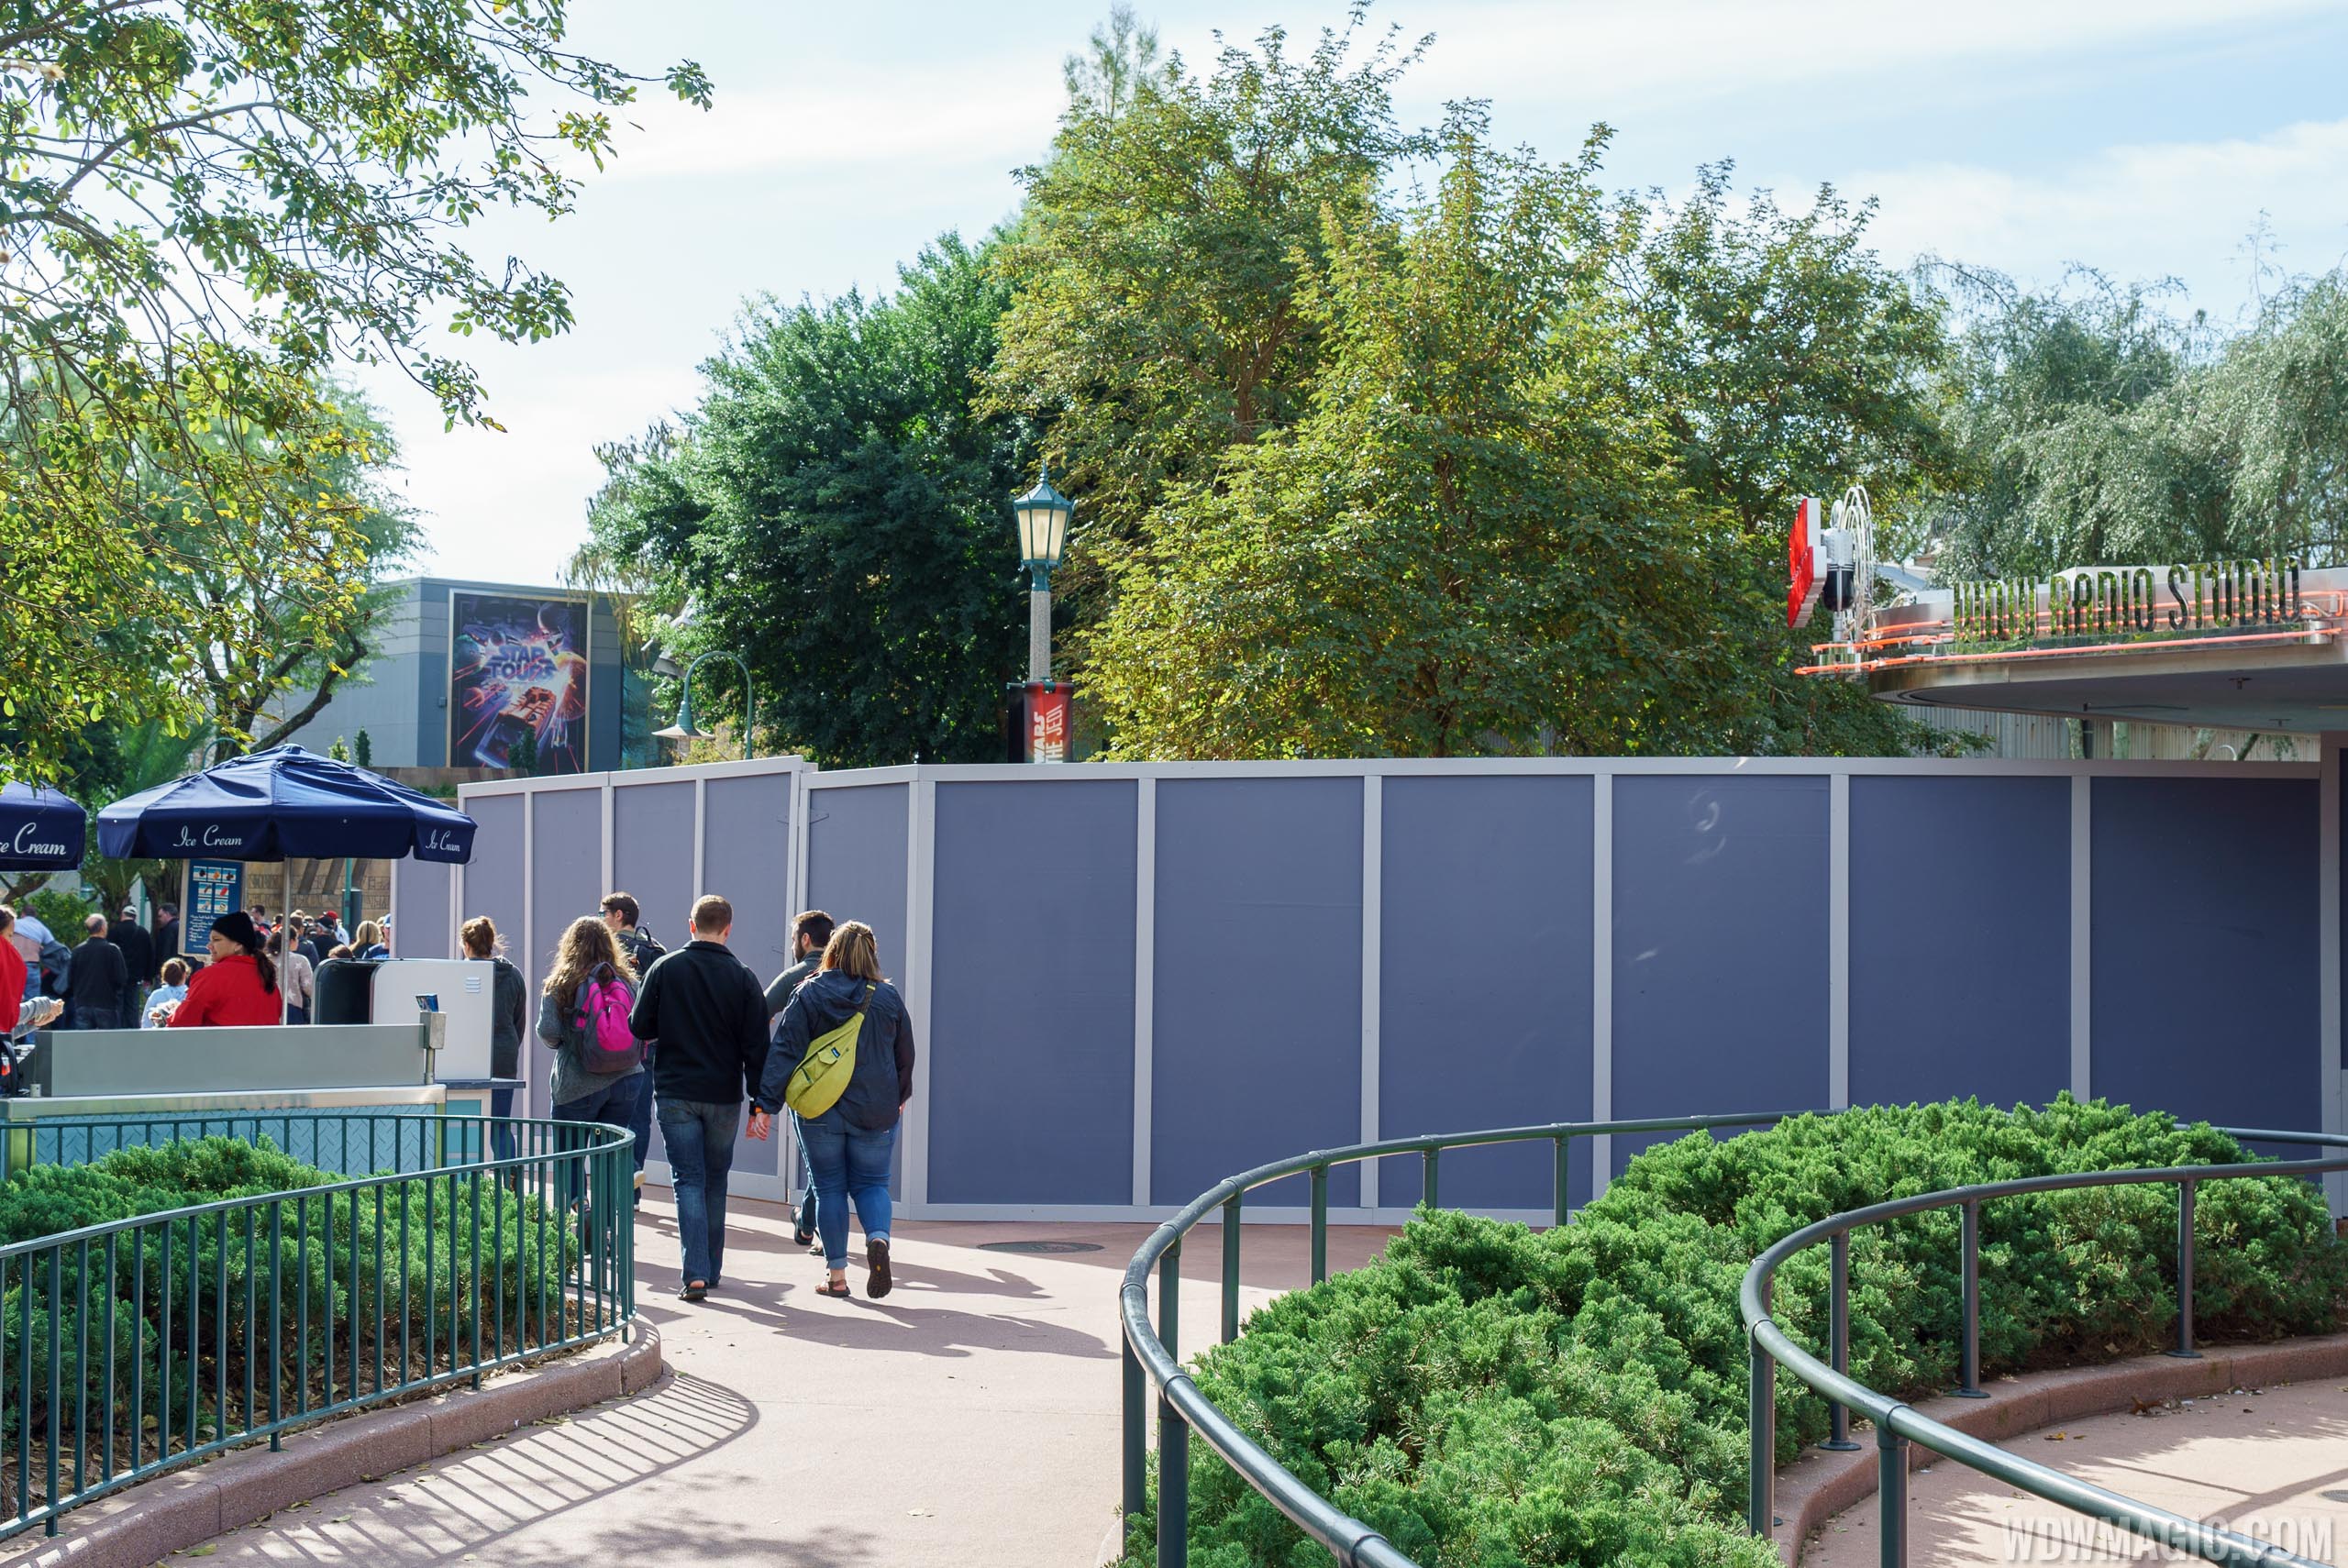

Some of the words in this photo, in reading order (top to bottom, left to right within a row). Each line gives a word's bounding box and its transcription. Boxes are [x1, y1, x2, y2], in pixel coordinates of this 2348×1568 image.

[2051, 566, 2155, 638] RADIO
[2167, 555, 2301, 631] STUDIO
[491, 645, 554, 663] STAR
[485, 659, 559, 680] TOURS
[1046, 703, 1064, 736] JEDI
[14, 822, 66, 856] Cream
[172, 825, 197, 847] Ice
[203, 824, 242, 846] Cream
